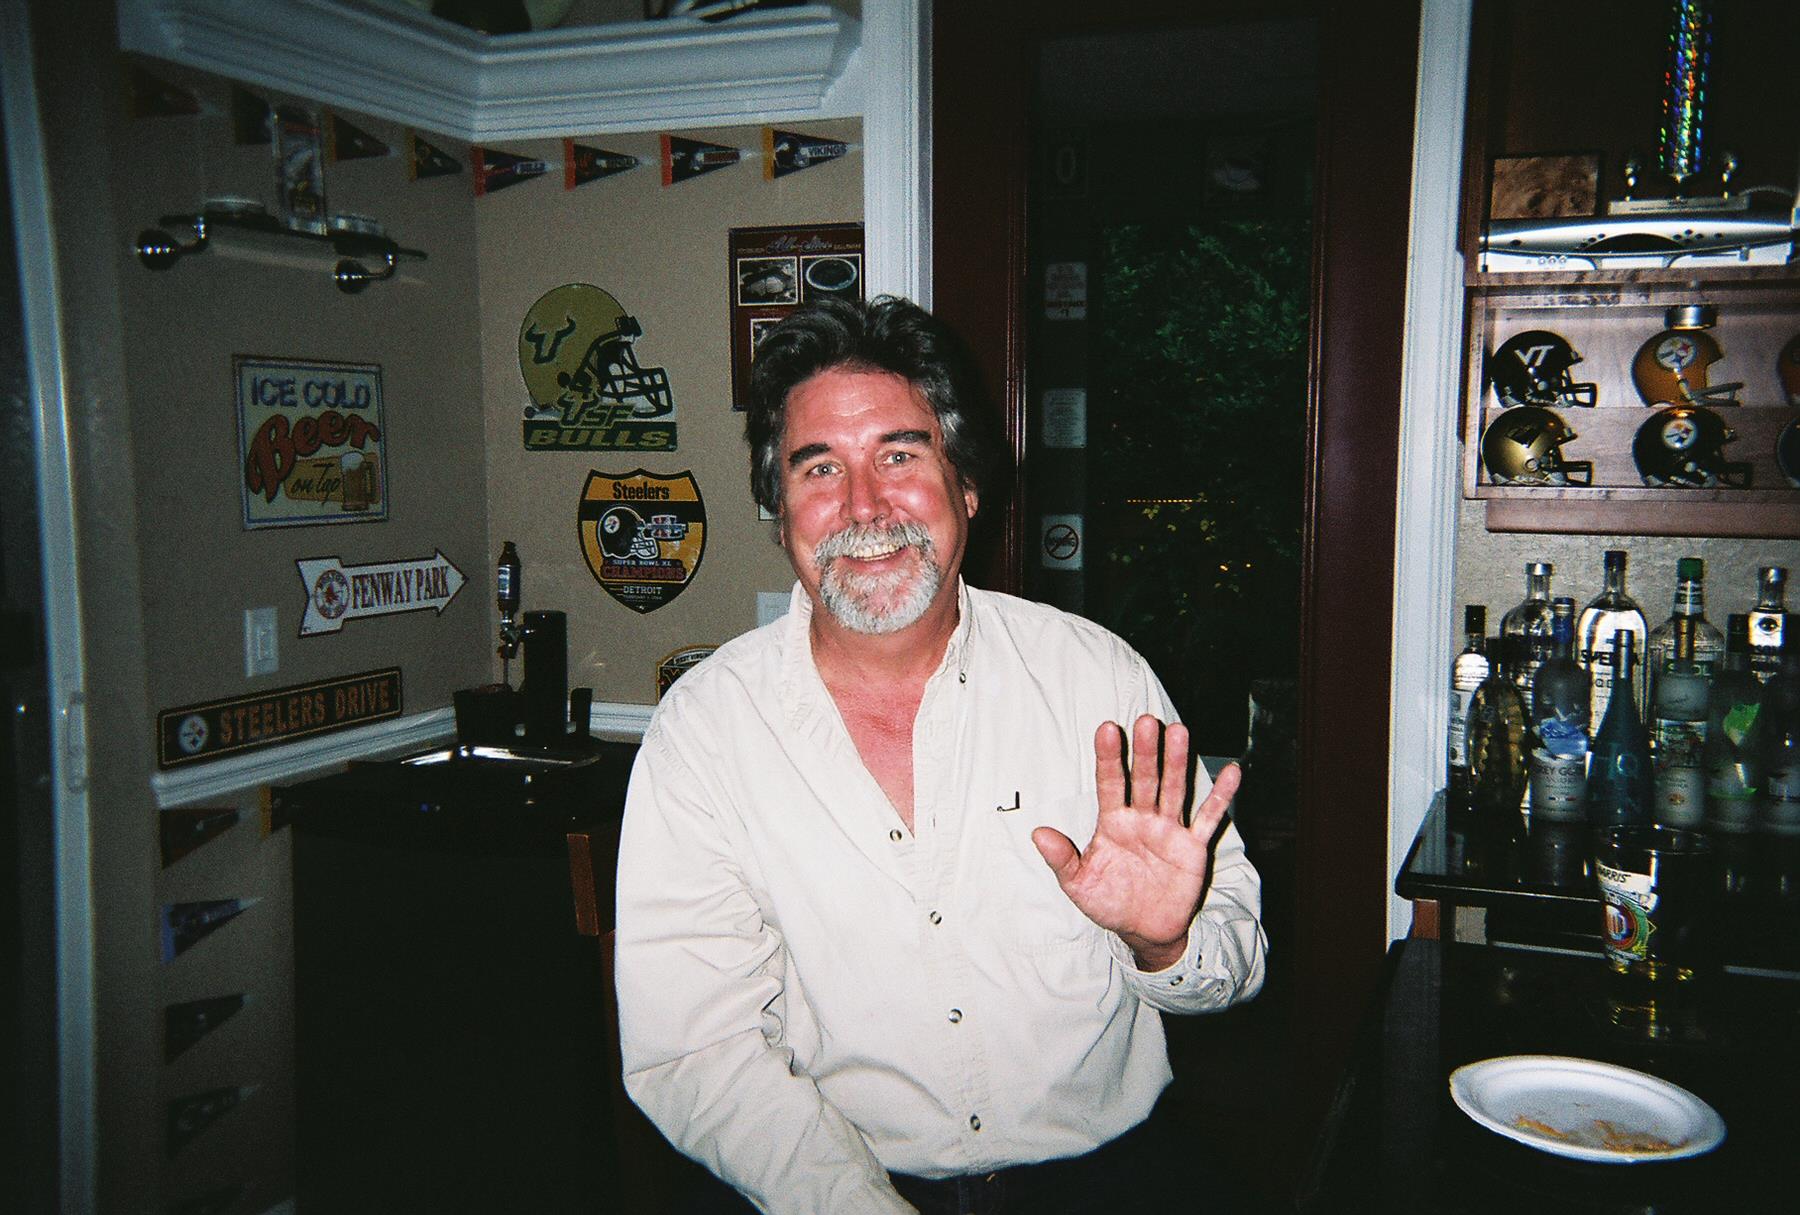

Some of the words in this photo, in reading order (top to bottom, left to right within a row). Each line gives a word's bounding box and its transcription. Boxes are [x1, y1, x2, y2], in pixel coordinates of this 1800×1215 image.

[808, 144, 847, 157] VIKINGS
[1513, 345, 1555, 366] VT
[251, 374, 297, 408] ICE
[303, 377, 371, 409] COLD
[528, 429, 671, 447] BULLS
[244, 410, 382, 504] Beer
[612, 481, 670, 499] Steelers
[612, 559, 637, 567] SUPER
[602, 566, 685, 580] CHAMPIONS
[352, 569, 413, 609] FENWAY
[415, 566, 450, 601] PARK
[623, 585, 663, 595] DETROIT
[219, 692, 326, 744] STEELERS
[335, 680, 391, 720] DRIVE
